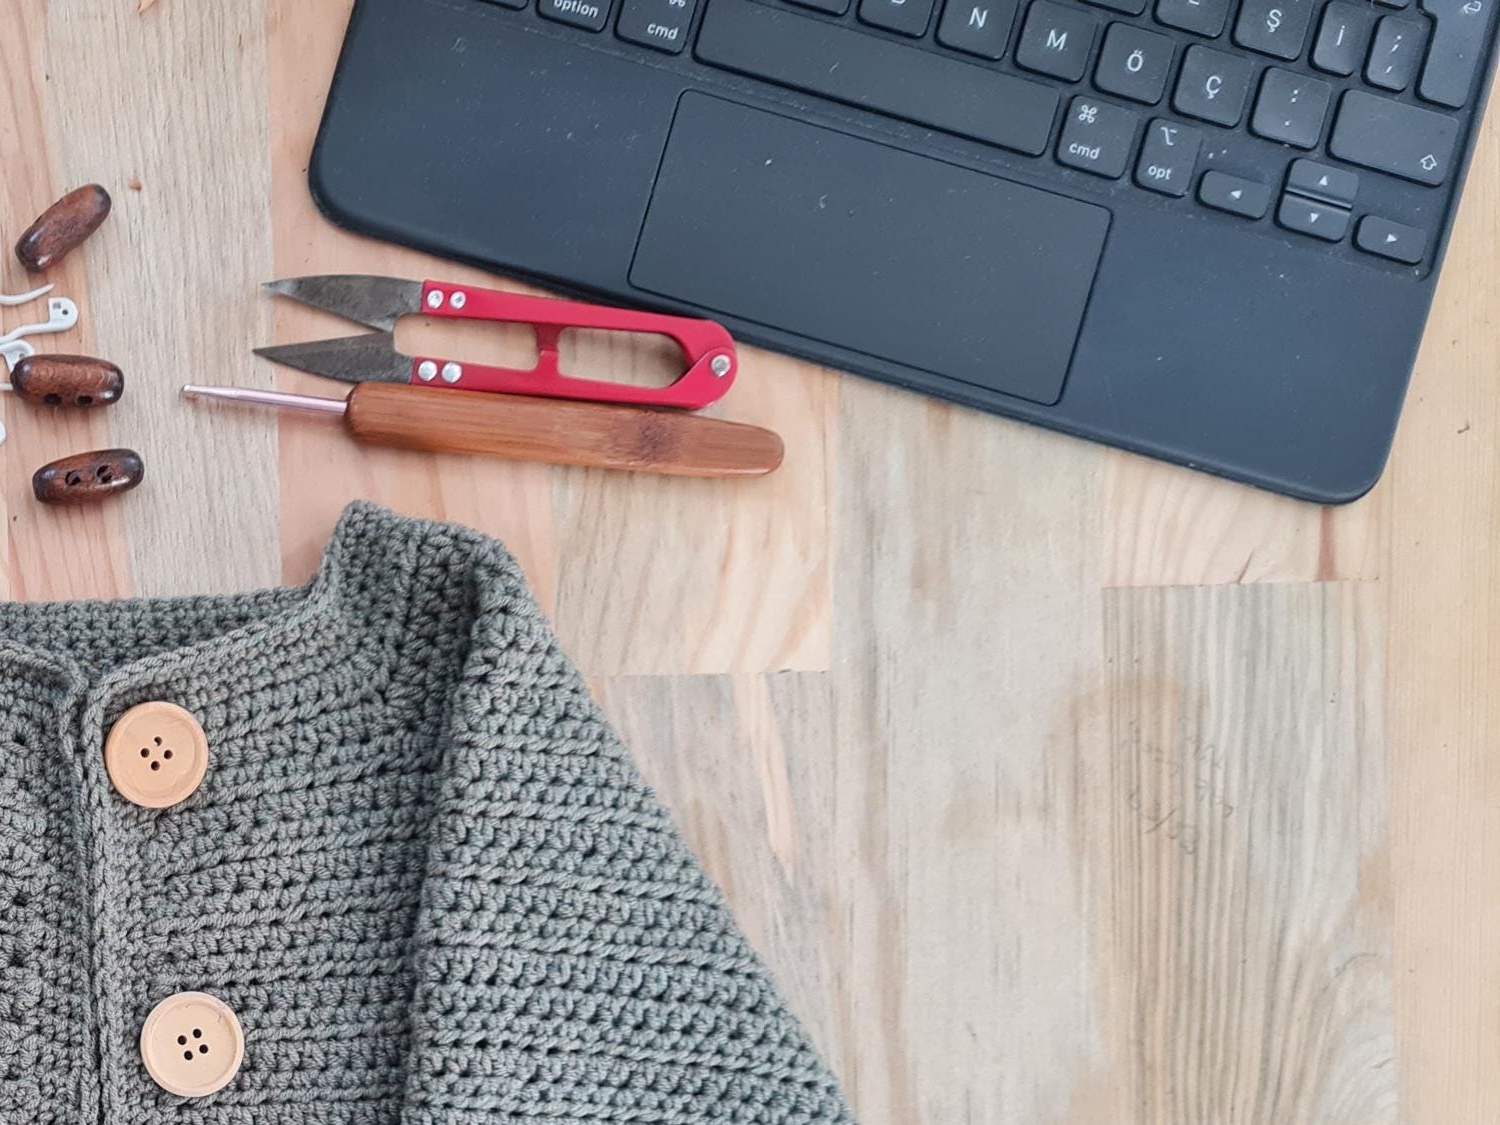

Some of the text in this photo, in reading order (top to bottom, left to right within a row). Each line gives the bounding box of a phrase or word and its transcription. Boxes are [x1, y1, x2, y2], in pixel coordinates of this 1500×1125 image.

[969, 7, 987, 28] N
[647, 22, 679, 40] cmd
[1046, 29, 1067, 51] M
[1126, 50, 1143, 72] Ö
[1205, 75, 1222, 99] Ç
[1068, 141, 1100, 160] cmd
[1148, 165, 1171, 180] opt
